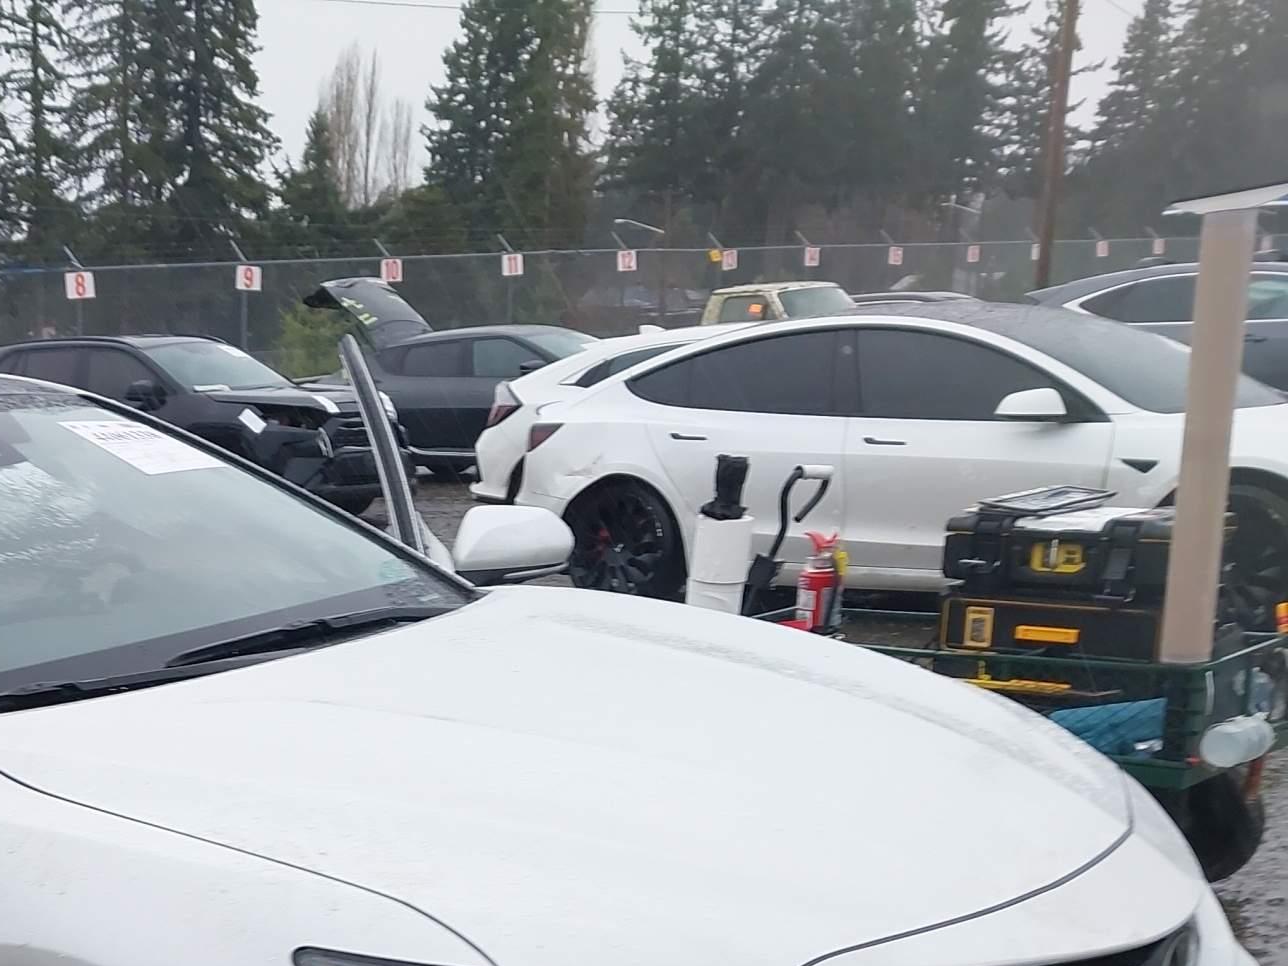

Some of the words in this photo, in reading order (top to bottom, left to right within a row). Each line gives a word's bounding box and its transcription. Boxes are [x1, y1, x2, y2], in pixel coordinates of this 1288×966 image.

[385, 260, 399, 280] 10
[507, 255, 519, 273] 11
[76, 271, 88, 297] 8
[243, 266, 255, 289] 9
